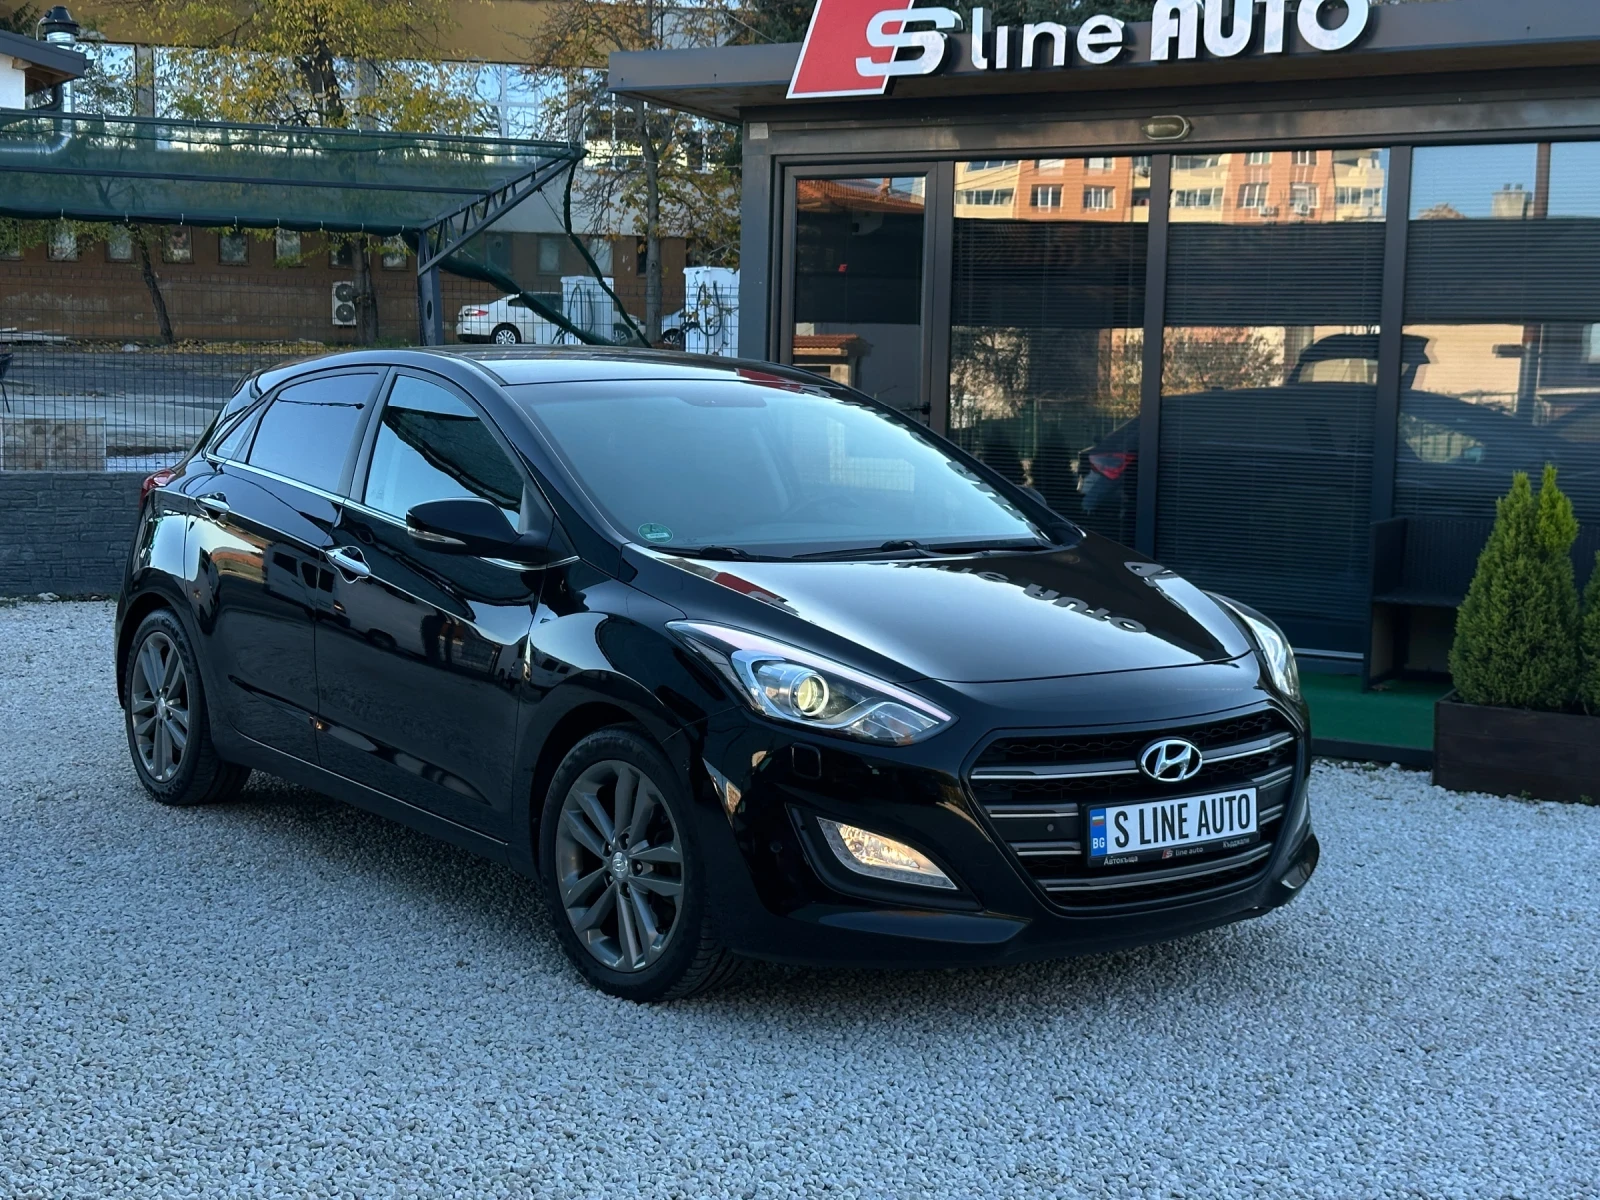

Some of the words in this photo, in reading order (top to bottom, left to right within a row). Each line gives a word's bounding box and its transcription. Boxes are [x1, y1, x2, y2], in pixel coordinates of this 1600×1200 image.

[855, 7, 956, 77] S
[971, 7, 1125, 70] line
[1150, 0, 1369, 61] AUTO
[1114, 810, 1129, 848] S
[1138, 803, 1189, 845] LINE
[1197, 793, 1250, 837] AUTO
[1092, 837, 1105, 849] BG
[1175, 848, 1188, 857] line
[1188, 846, 1204, 855] auto
